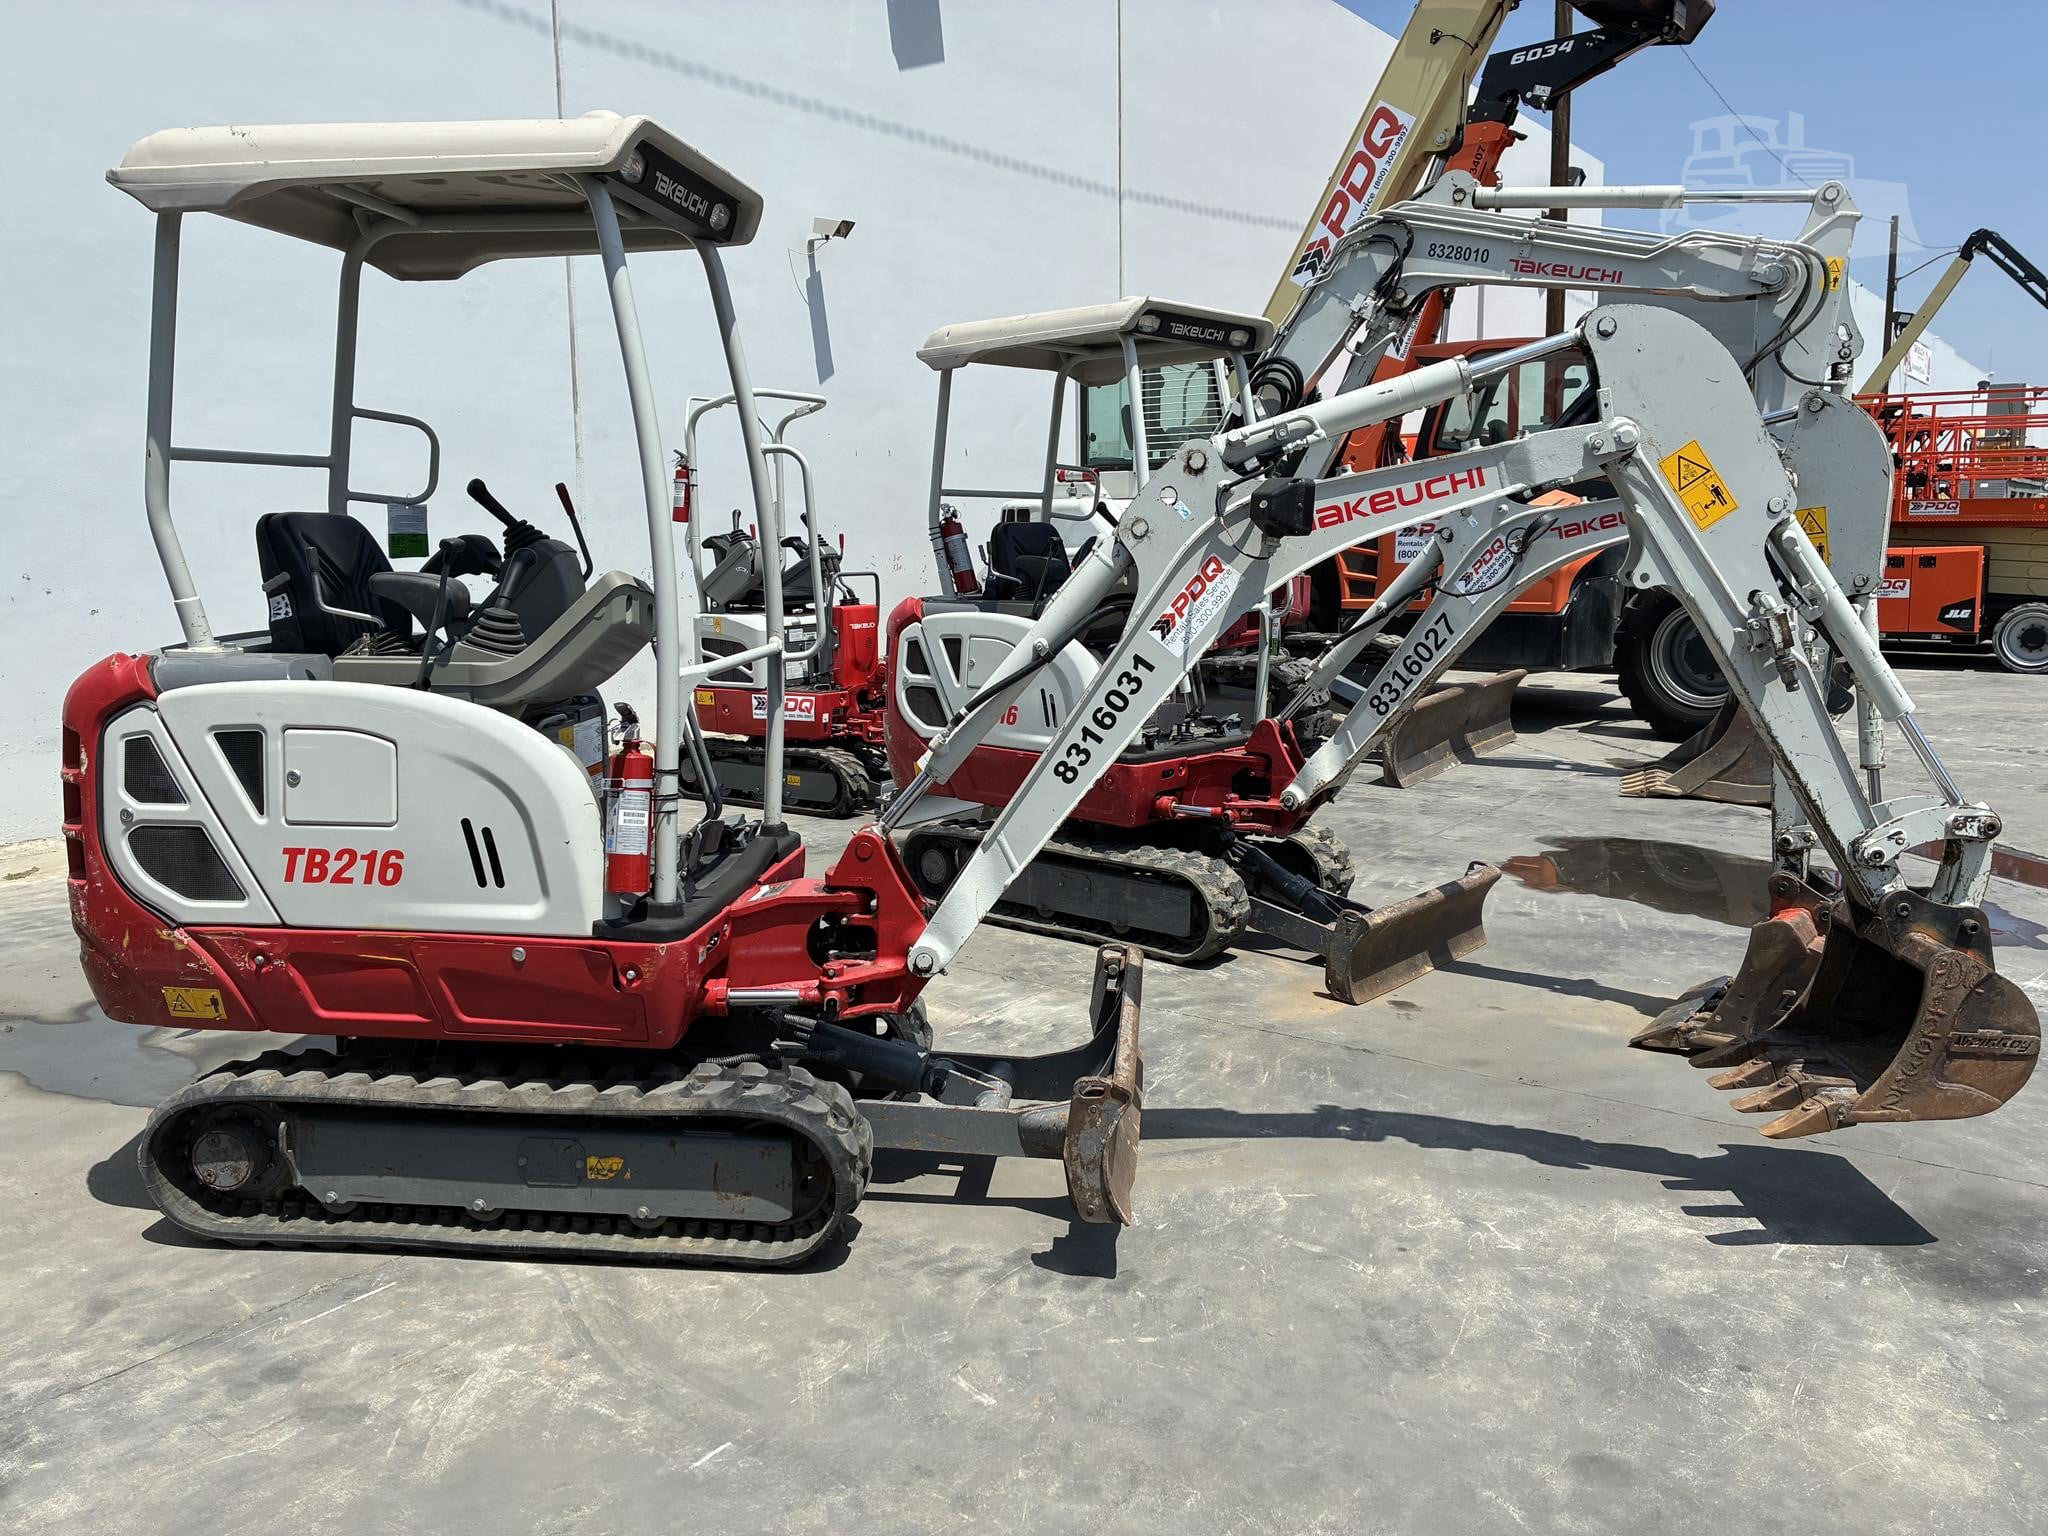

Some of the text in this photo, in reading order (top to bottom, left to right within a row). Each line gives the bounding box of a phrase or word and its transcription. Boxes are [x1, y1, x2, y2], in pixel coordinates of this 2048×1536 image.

[1510, 40, 1574, 65] 6034
[1320, 106, 1404, 239] PDQ
[1354, 192, 1376, 223] ervice
[1385, 126, 1409, 167] 300-9997
[1427, 243, 1489, 263] 8328010
[1924, 501, 1959, 511] PDQ
[1472, 537, 1505, 575] PDQ
[1171, 555, 1225, 619] PDQ
[1181, 585, 1231, 645] 800-300-9997
[1944, 609, 1971, 618] JLG
[1369, 612, 1455, 716] 8316027
[1053, 653, 1156, 784] 8316031
[282, 847, 405, 887] TB216
